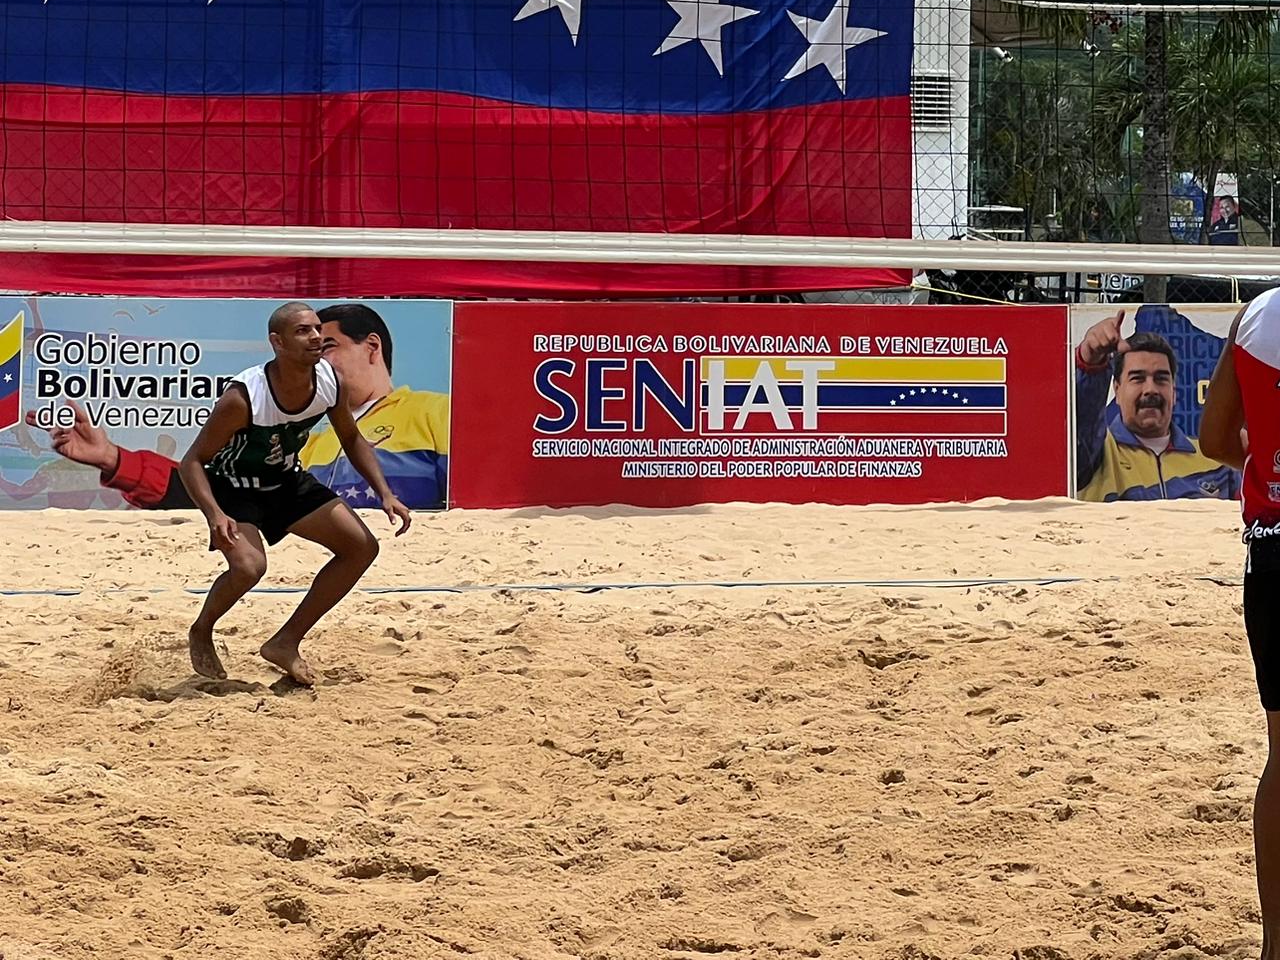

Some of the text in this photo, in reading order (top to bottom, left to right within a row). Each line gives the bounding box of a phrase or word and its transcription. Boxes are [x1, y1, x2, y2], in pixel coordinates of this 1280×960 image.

[35, 333, 201, 366] Gobierno
[533, 335, 1009, 354] REPUBLICA BOLIVARIANA DE VENEZUELA
[533, 357, 836, 434] SENIAT
[37, 401, 213, 428] de Venezue
[532, 435, 1008, 457] SERVICIO NACIONAL INTEGRADO DE ADMINISTRACIÓN ADUANERA Y TRIBUTARIA
[622, 461, 922, 478] MINISTERIO DEL PODER POPULAR DE FINANZAS
